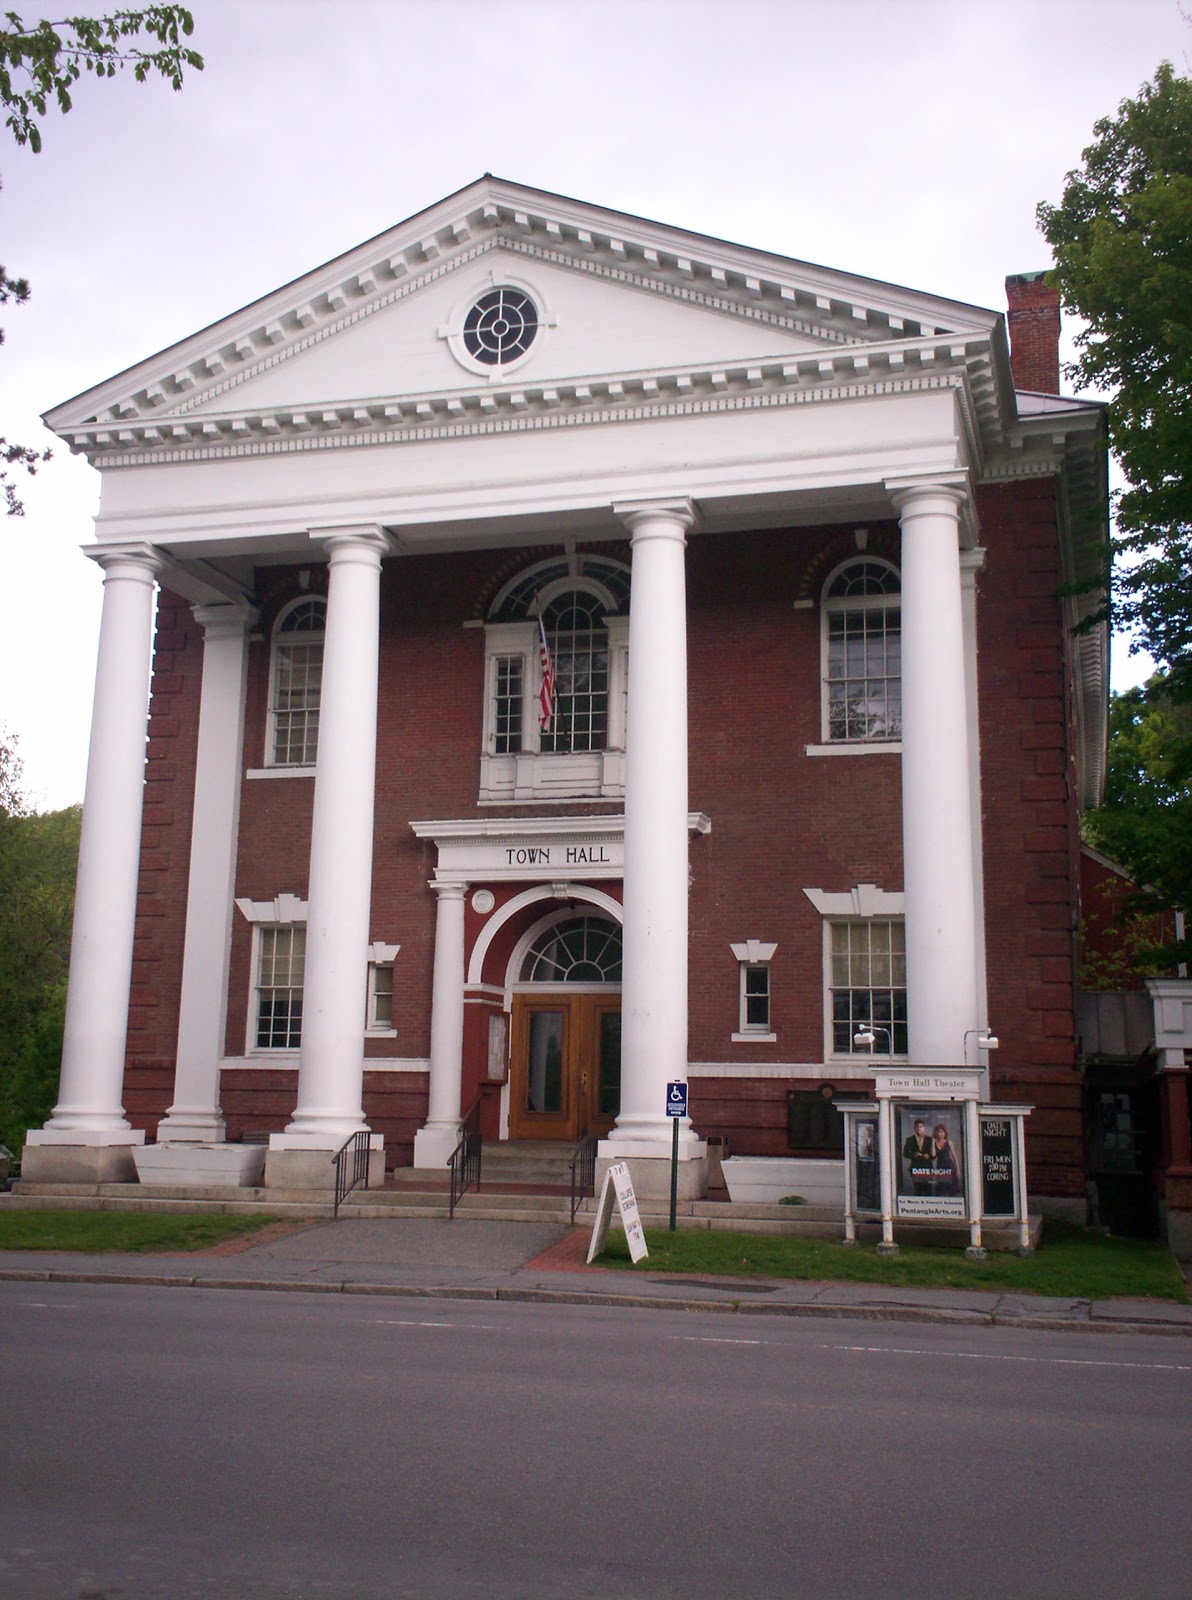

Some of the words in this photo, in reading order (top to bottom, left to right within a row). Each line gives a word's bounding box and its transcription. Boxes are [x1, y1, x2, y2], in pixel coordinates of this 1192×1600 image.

[505, 848, 550, 864] TOWN
[566, 846, 610, 863] HALL
[888, 1078, 909, 1086] Town
[913, 1079, 930, 1087] Hall
[933, 1079, 965, 1087] Theater
[986, 1121, 1005, 1130] DATE
[984, 1129, 1006, 1137] NIGHT
[912, 1167, 930, 1175] DATE
[901, 1208, 962, 1216] PentangleArts.org
